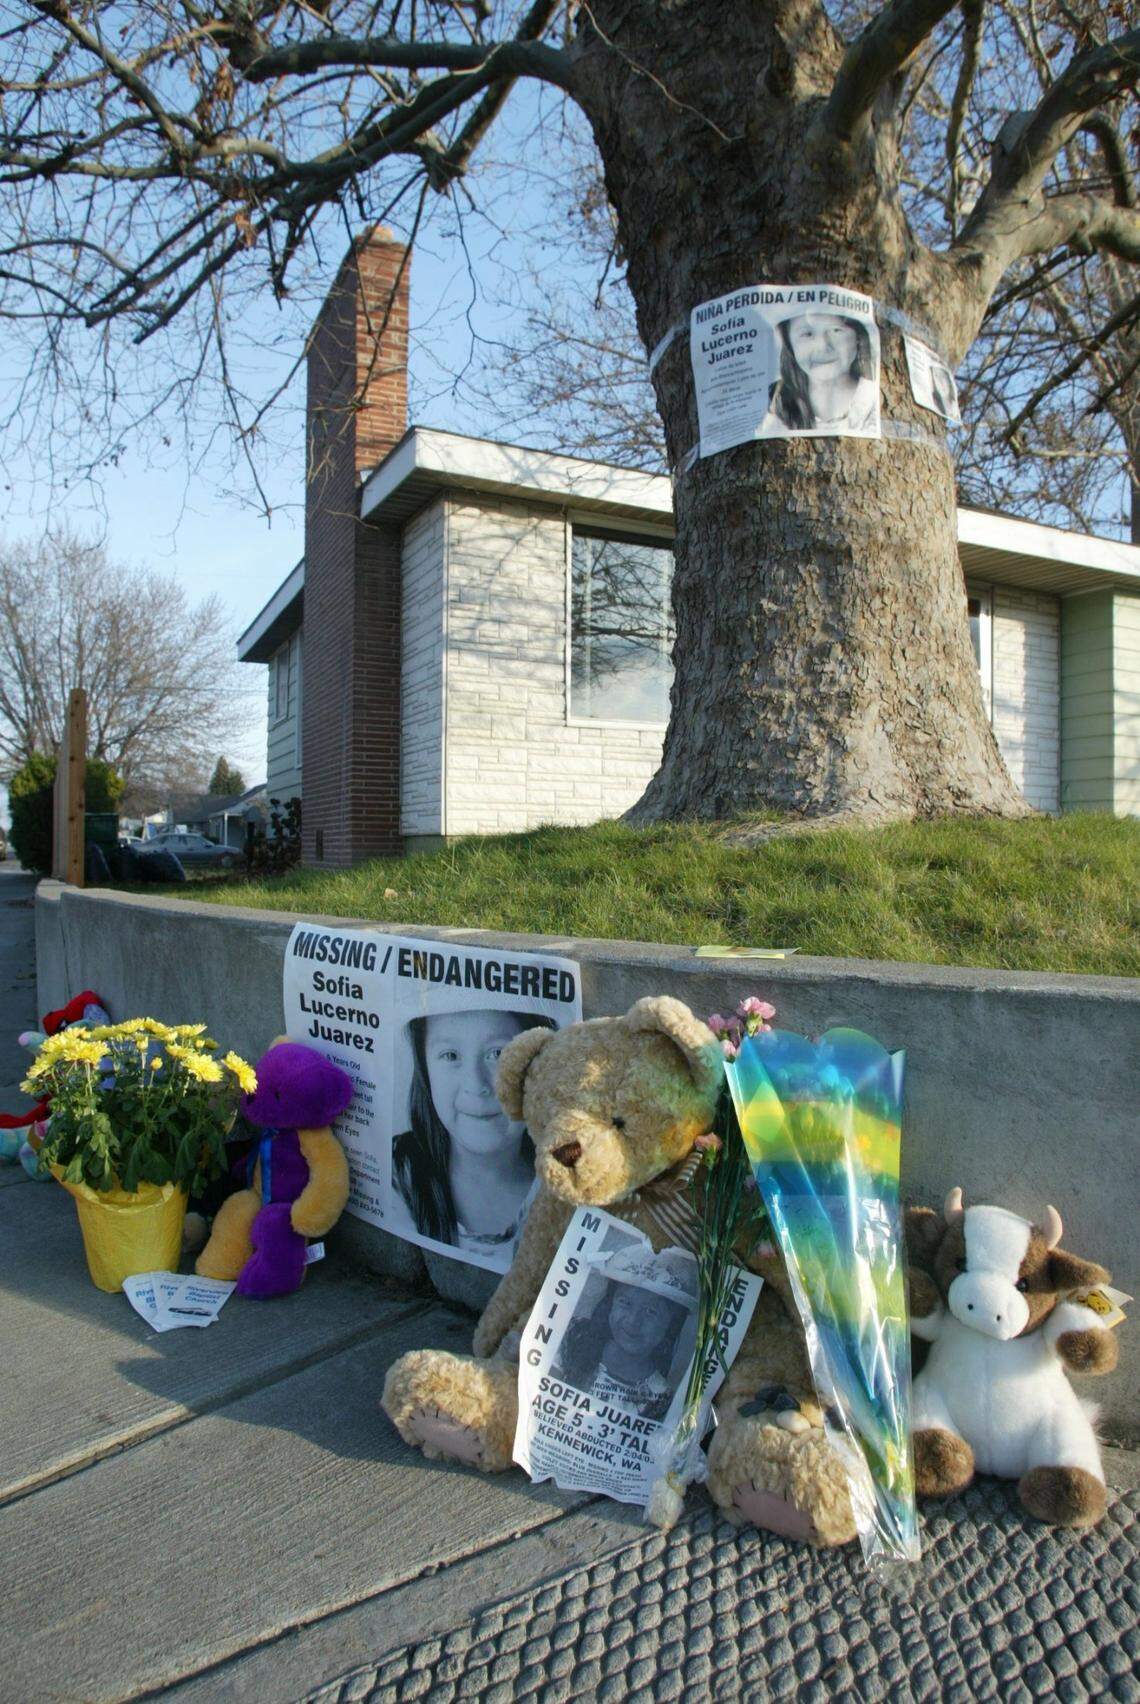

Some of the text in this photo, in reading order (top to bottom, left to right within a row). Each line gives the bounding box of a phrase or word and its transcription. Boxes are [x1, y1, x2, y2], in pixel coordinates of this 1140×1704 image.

[726, 292, 784, 313] PERDIDA
[797, 291, 815, 302] EN
[819, 290, 870, 314] PELIGRO
[701, 329, 757, 352] Lucerno
[711, 317, 745, 335] Sofia
[708, 343, 753, 365] Juarez
[293, 931, 575, 1003] MISSING / ENDANGERED
[313, 971, 363, 1000] Sofia
[300, 993, 380, 1029] Lucerno
[309, 1020, 374, 1053] Juarez
[356, 1076, 377, 1091] Female
[345, 1125, 360, 1137] Eyes
[355, 1114, 369, 1126] back
[527, 1212, 601, 1367] MISSING
[539, 1377, 661, 1436] SOFIA JUARE
[532, 1394, 568, 1421] AGE
[572, 1412, 584, 1428] 5
[620, 1432, 650, 1455] TAL
[533, 1409, 574, 1433] BELIEVED
[575, 1430, 622, 1453] ABDUCTED
[538, 1423, 616, 1467] KENNEWICK,
[621, 1458, 641, 1472] WA
